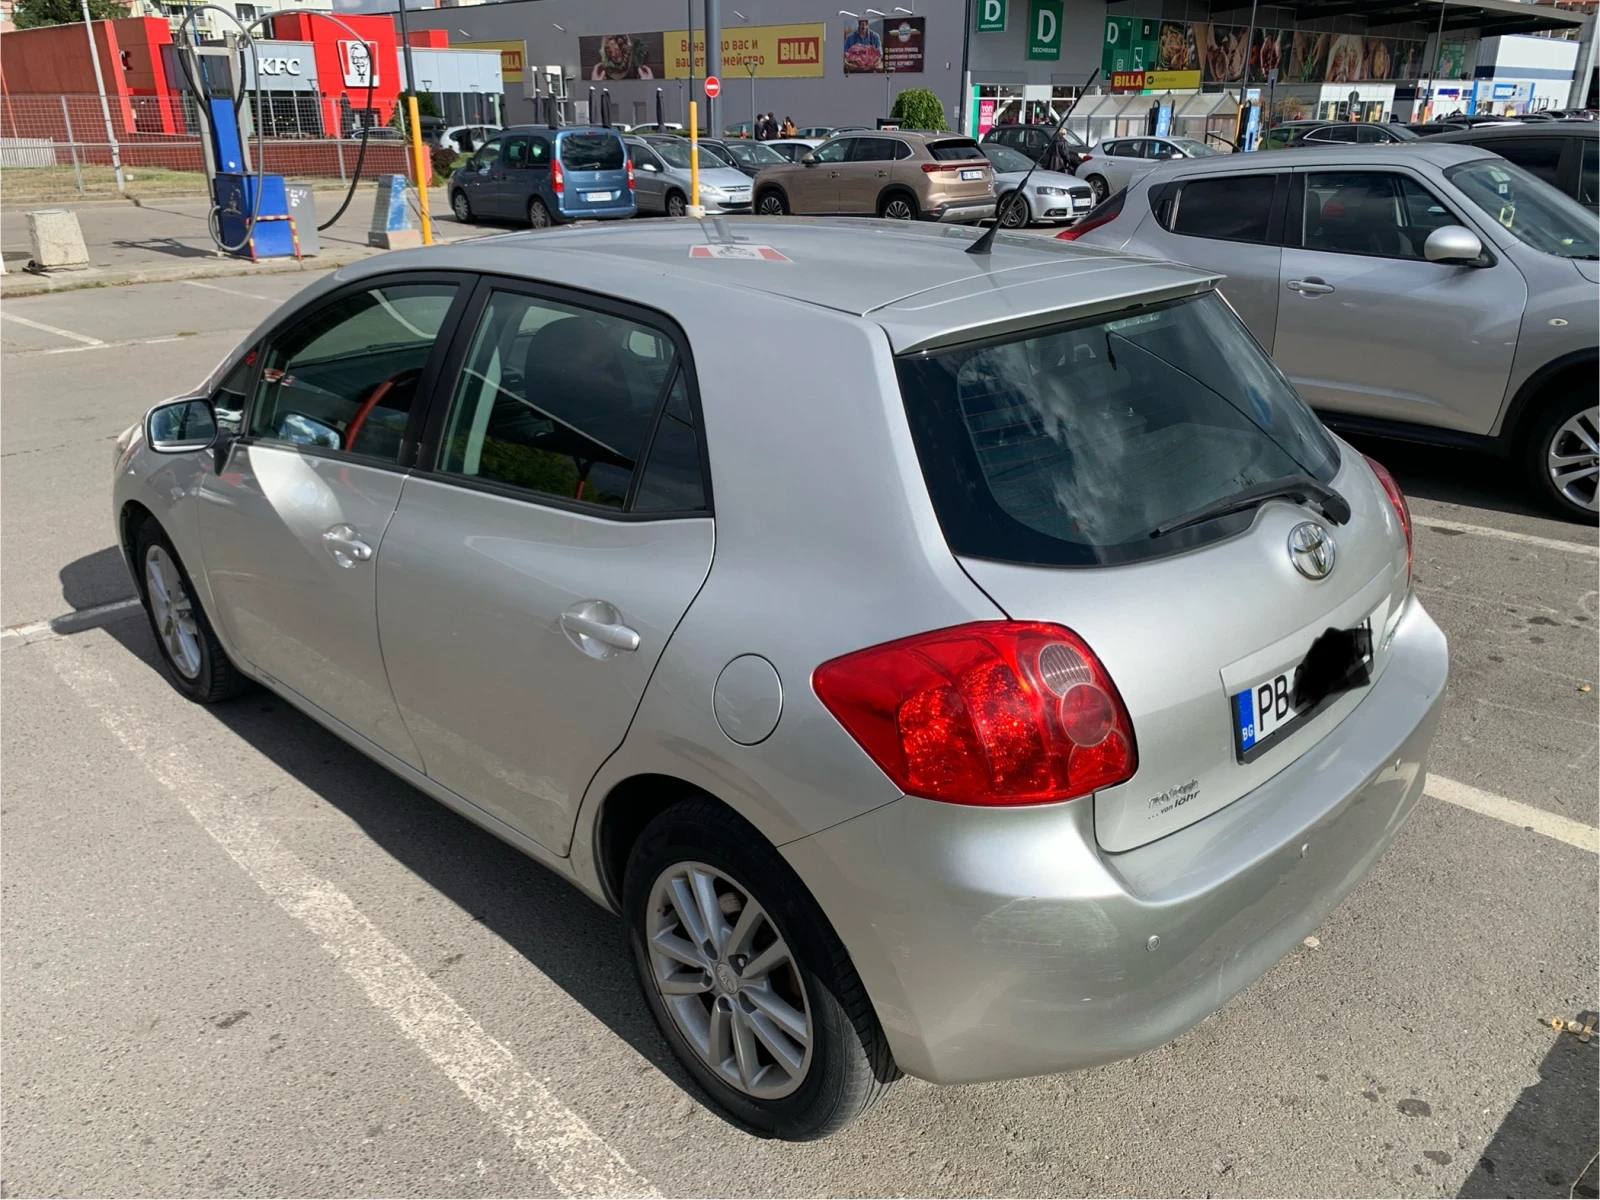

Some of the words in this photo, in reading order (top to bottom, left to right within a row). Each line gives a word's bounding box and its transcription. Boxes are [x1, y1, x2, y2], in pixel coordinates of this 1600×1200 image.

[1037, 9, 1057, 43] D
[1106, 22, 1119, 44] D
[732, 39, 749, 51] вас
[752, 39, 758, 50] и
[780, 42, 816, 60] BILLA
[257, 57, 301, 76] KFC
[1113, 74, 1143, 87] BILLA
[1257, 674, 1290, 732] PB
[1242, 724, 1255, 741] BG
[1160, 804, 1173, 814] von
[1174, 790, 1200, 808] löhr
